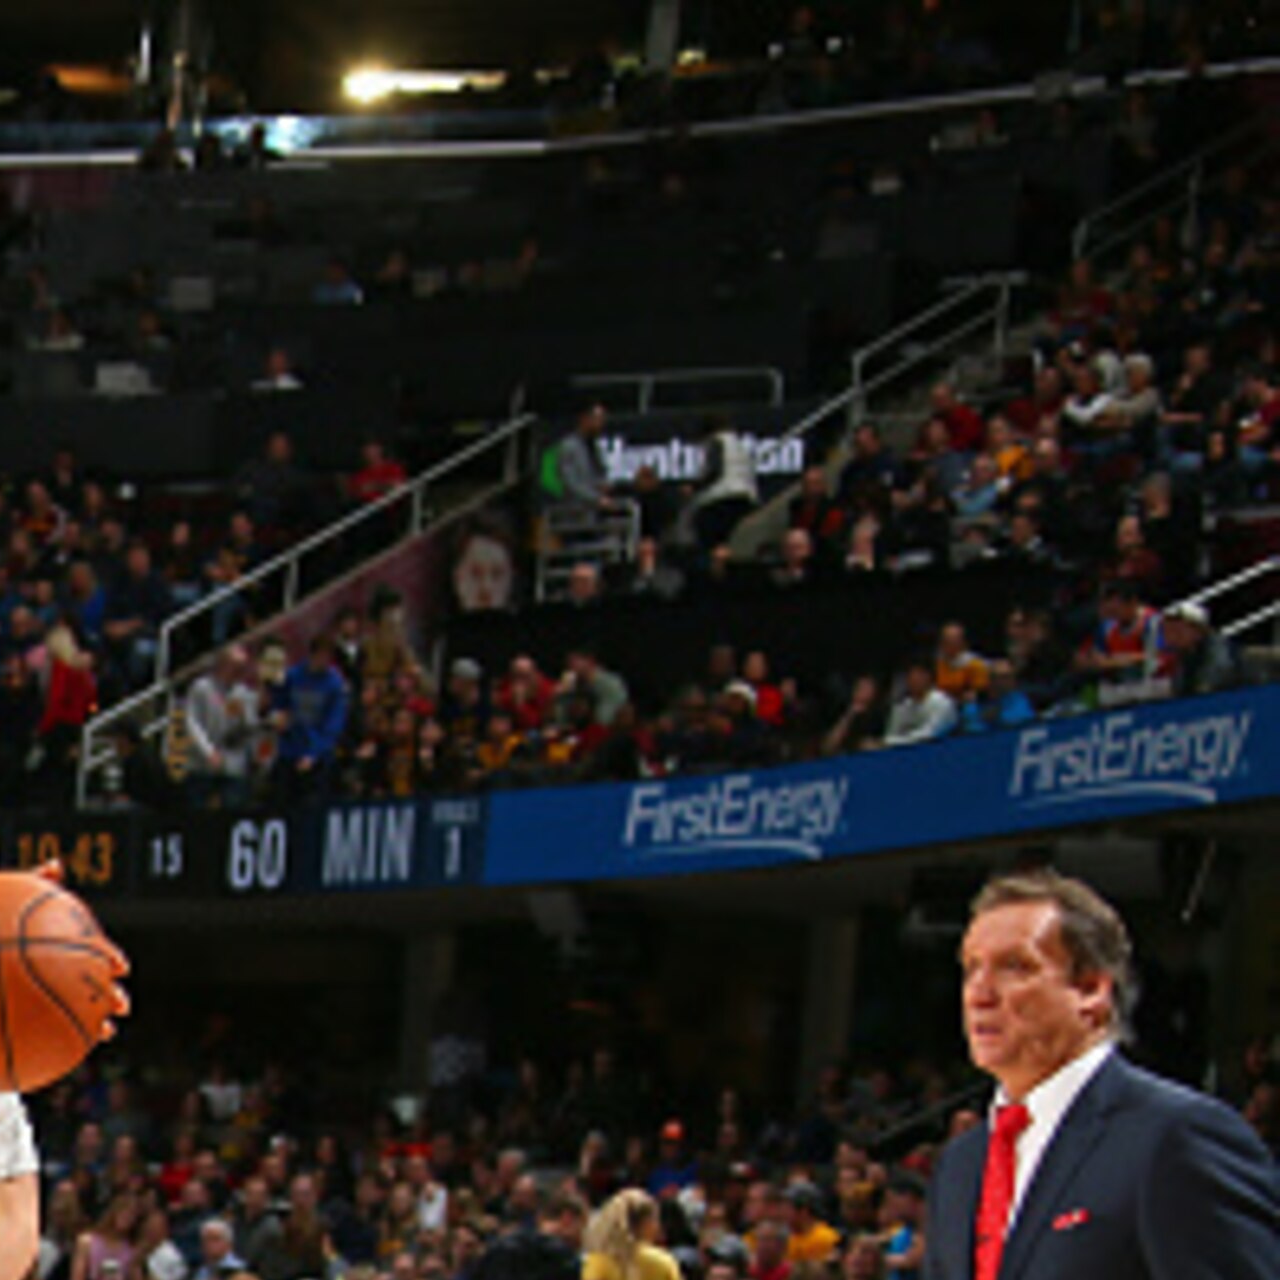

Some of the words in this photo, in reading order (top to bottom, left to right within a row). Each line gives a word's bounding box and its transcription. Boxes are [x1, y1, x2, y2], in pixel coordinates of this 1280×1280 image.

[1009, 713, 1252, 796] FirstEnergy
[321, 805, 417, 886] MIN
[623, 775, 849, 845] FirstEnergy
[227, 818, 288, 890] 60
